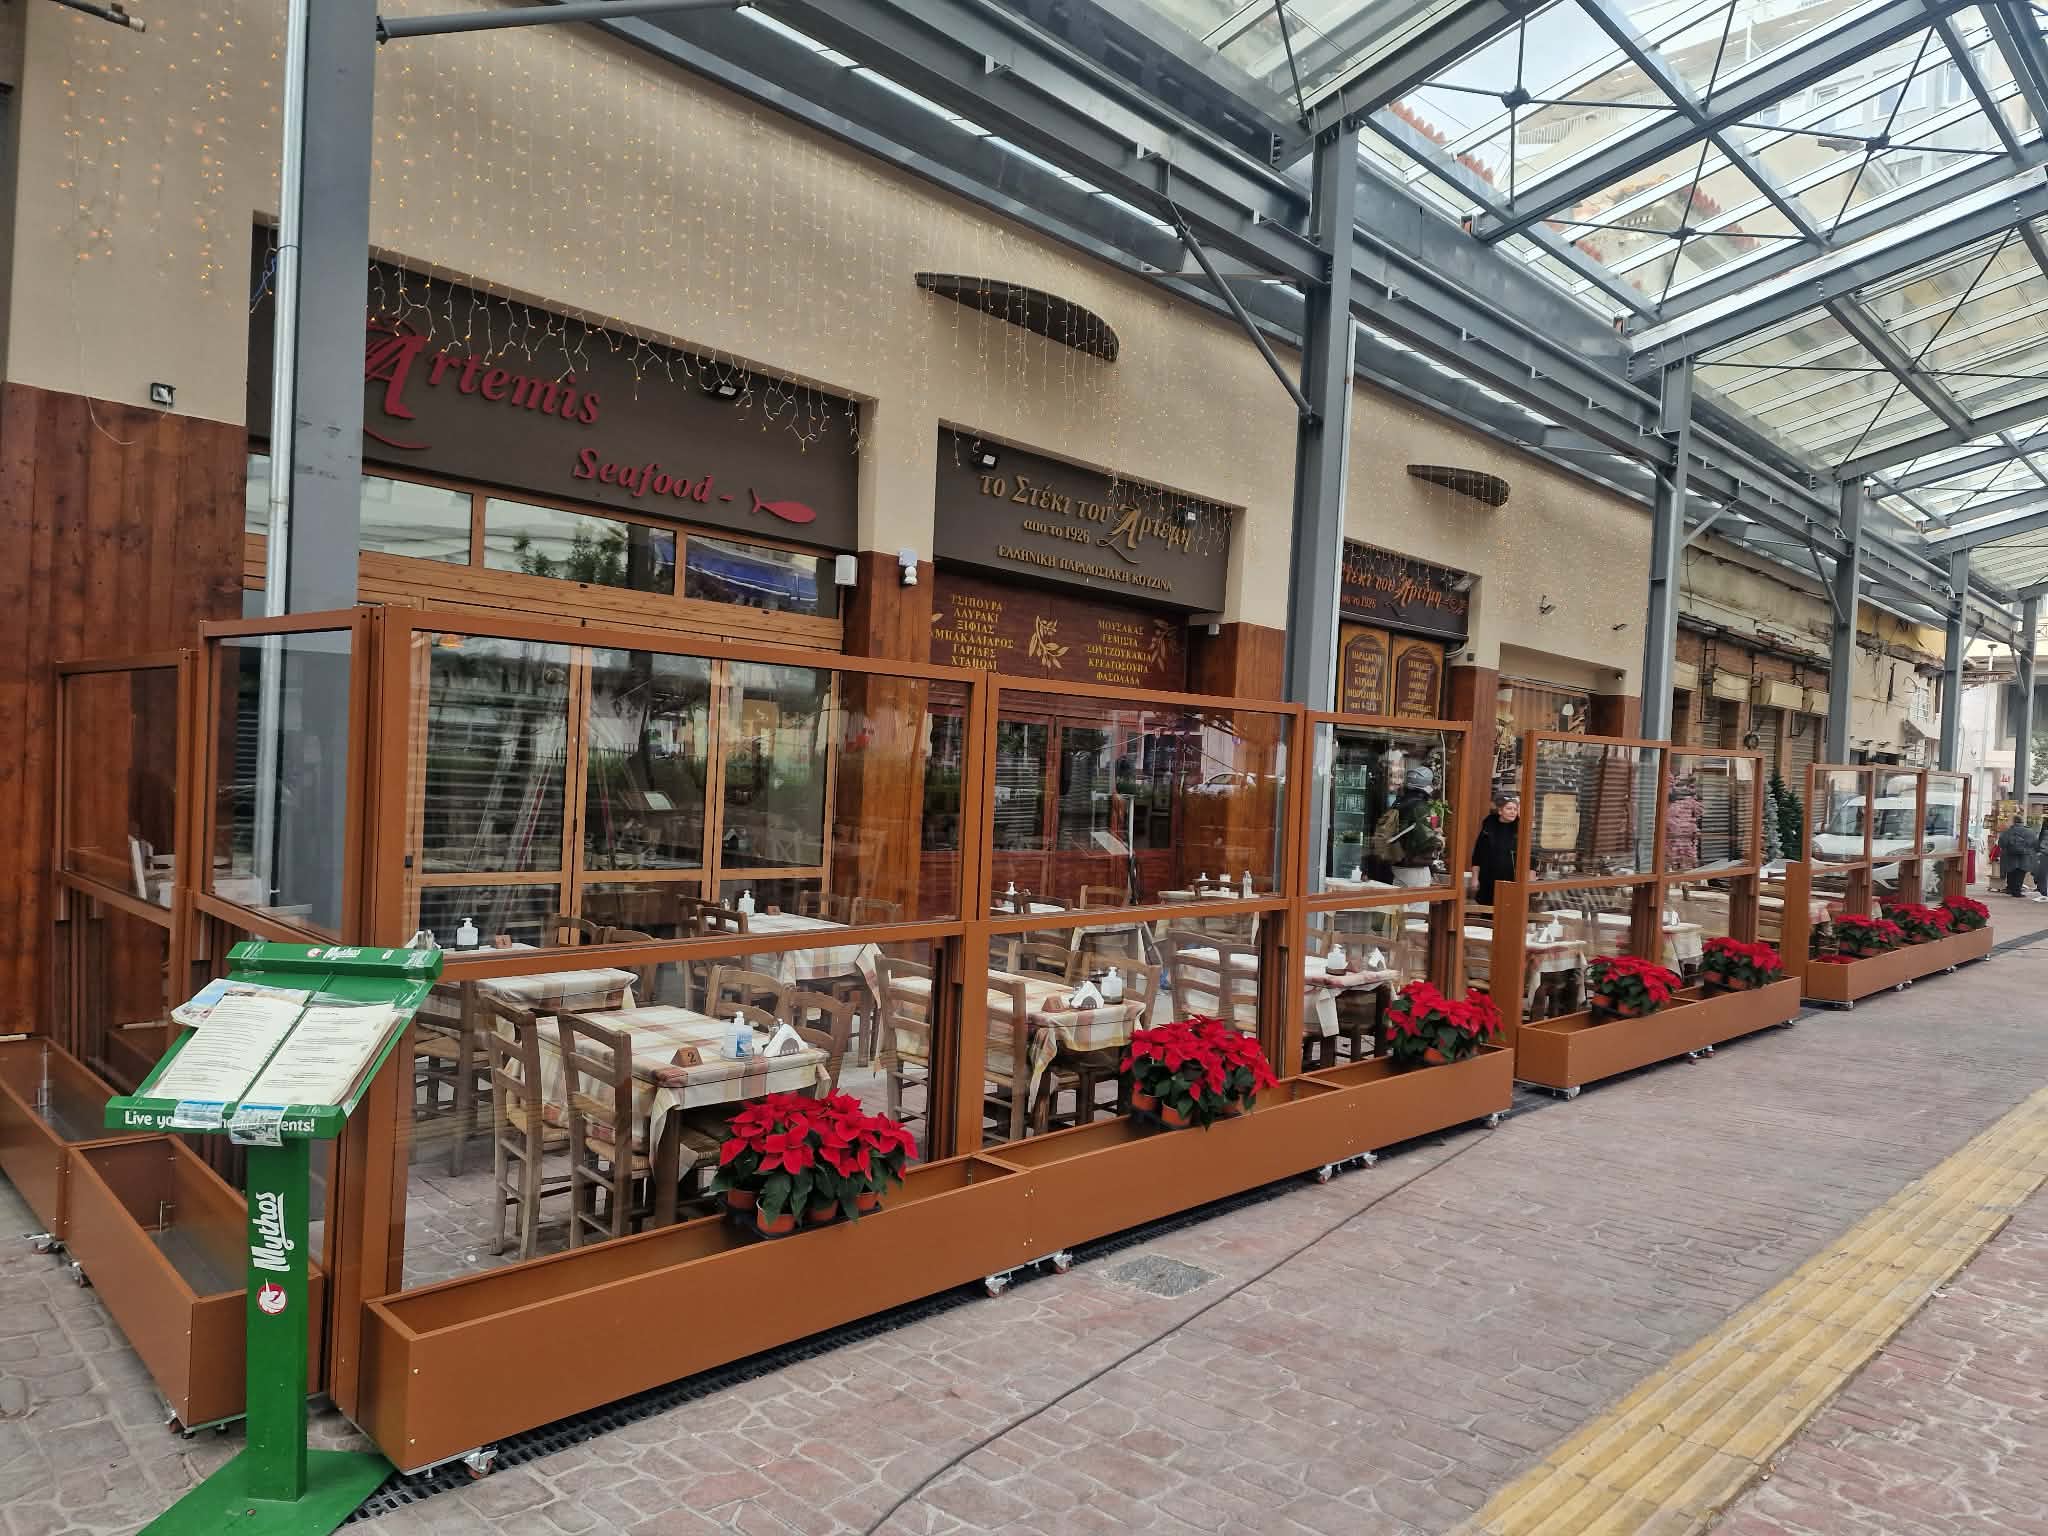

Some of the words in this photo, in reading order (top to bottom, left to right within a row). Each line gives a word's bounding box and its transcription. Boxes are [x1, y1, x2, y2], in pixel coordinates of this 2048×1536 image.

[366, 318, 600, 424] Artemis
[573, 447, 714, 503] Seafood
[1012, 475, 1072, 514] Στέκι
[1065, 526, 1090, 544] 1926
[998, 544, 1056, 567] ΕΛΛΗΝΙΚΗ
[1059, 558, 1129, 582] ΠΑΡΑΔΟΣΙΑΚΗ
[1131, 573, 1172, 592] ΚΟΥΖΙΝΑ
[935, 629, 1014, 649] ΜΠΑΚΑΛΙΑΡΟΣ
[957, 620, 994, 634] ΞΙΦΙΑΣ
[686, 1051, 697, 1065] 2
[124, 1110, 153, 1126] Live
[251, 1190, 295, 1273] Mythos
